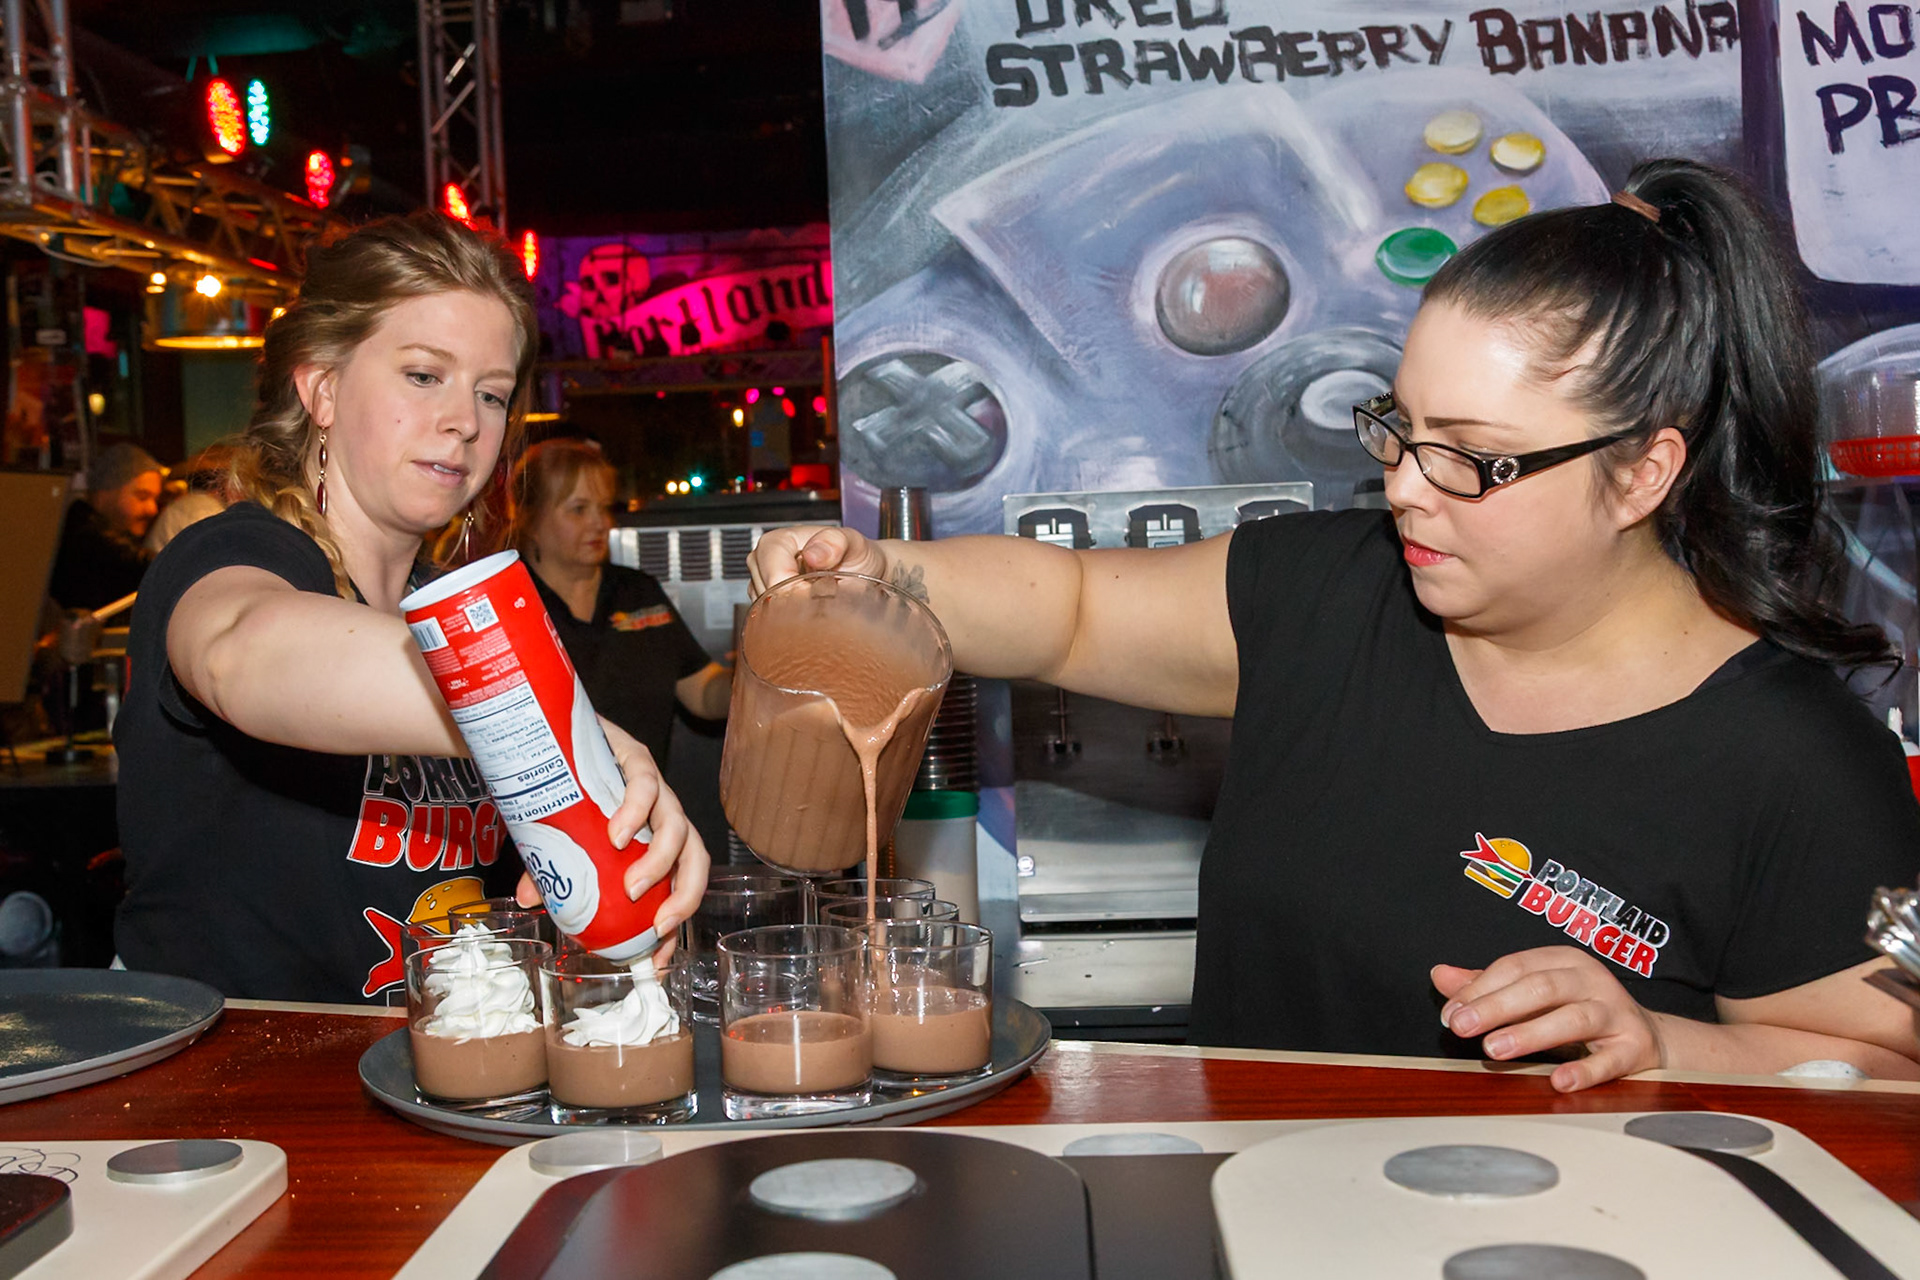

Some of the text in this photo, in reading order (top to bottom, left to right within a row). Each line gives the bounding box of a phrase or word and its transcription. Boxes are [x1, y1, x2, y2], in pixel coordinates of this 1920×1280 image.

[986, 19, 1454, 107] STRAWBERRY
[1469, 0, 1740, 75] BANANA
[1796, 0, 1920, 66] MO
[592, 258, 833, 356] rtland
[364, 755, 492, 803] PORTL
[517, 758, 564, 782] Calories
[524, 791, 580, 818] Nutrition
[346, 794, 506, 872] BURG
[1518, 880, 1659, 978] BURGER
[1535, 858, 1670, 948] PORTLAND
